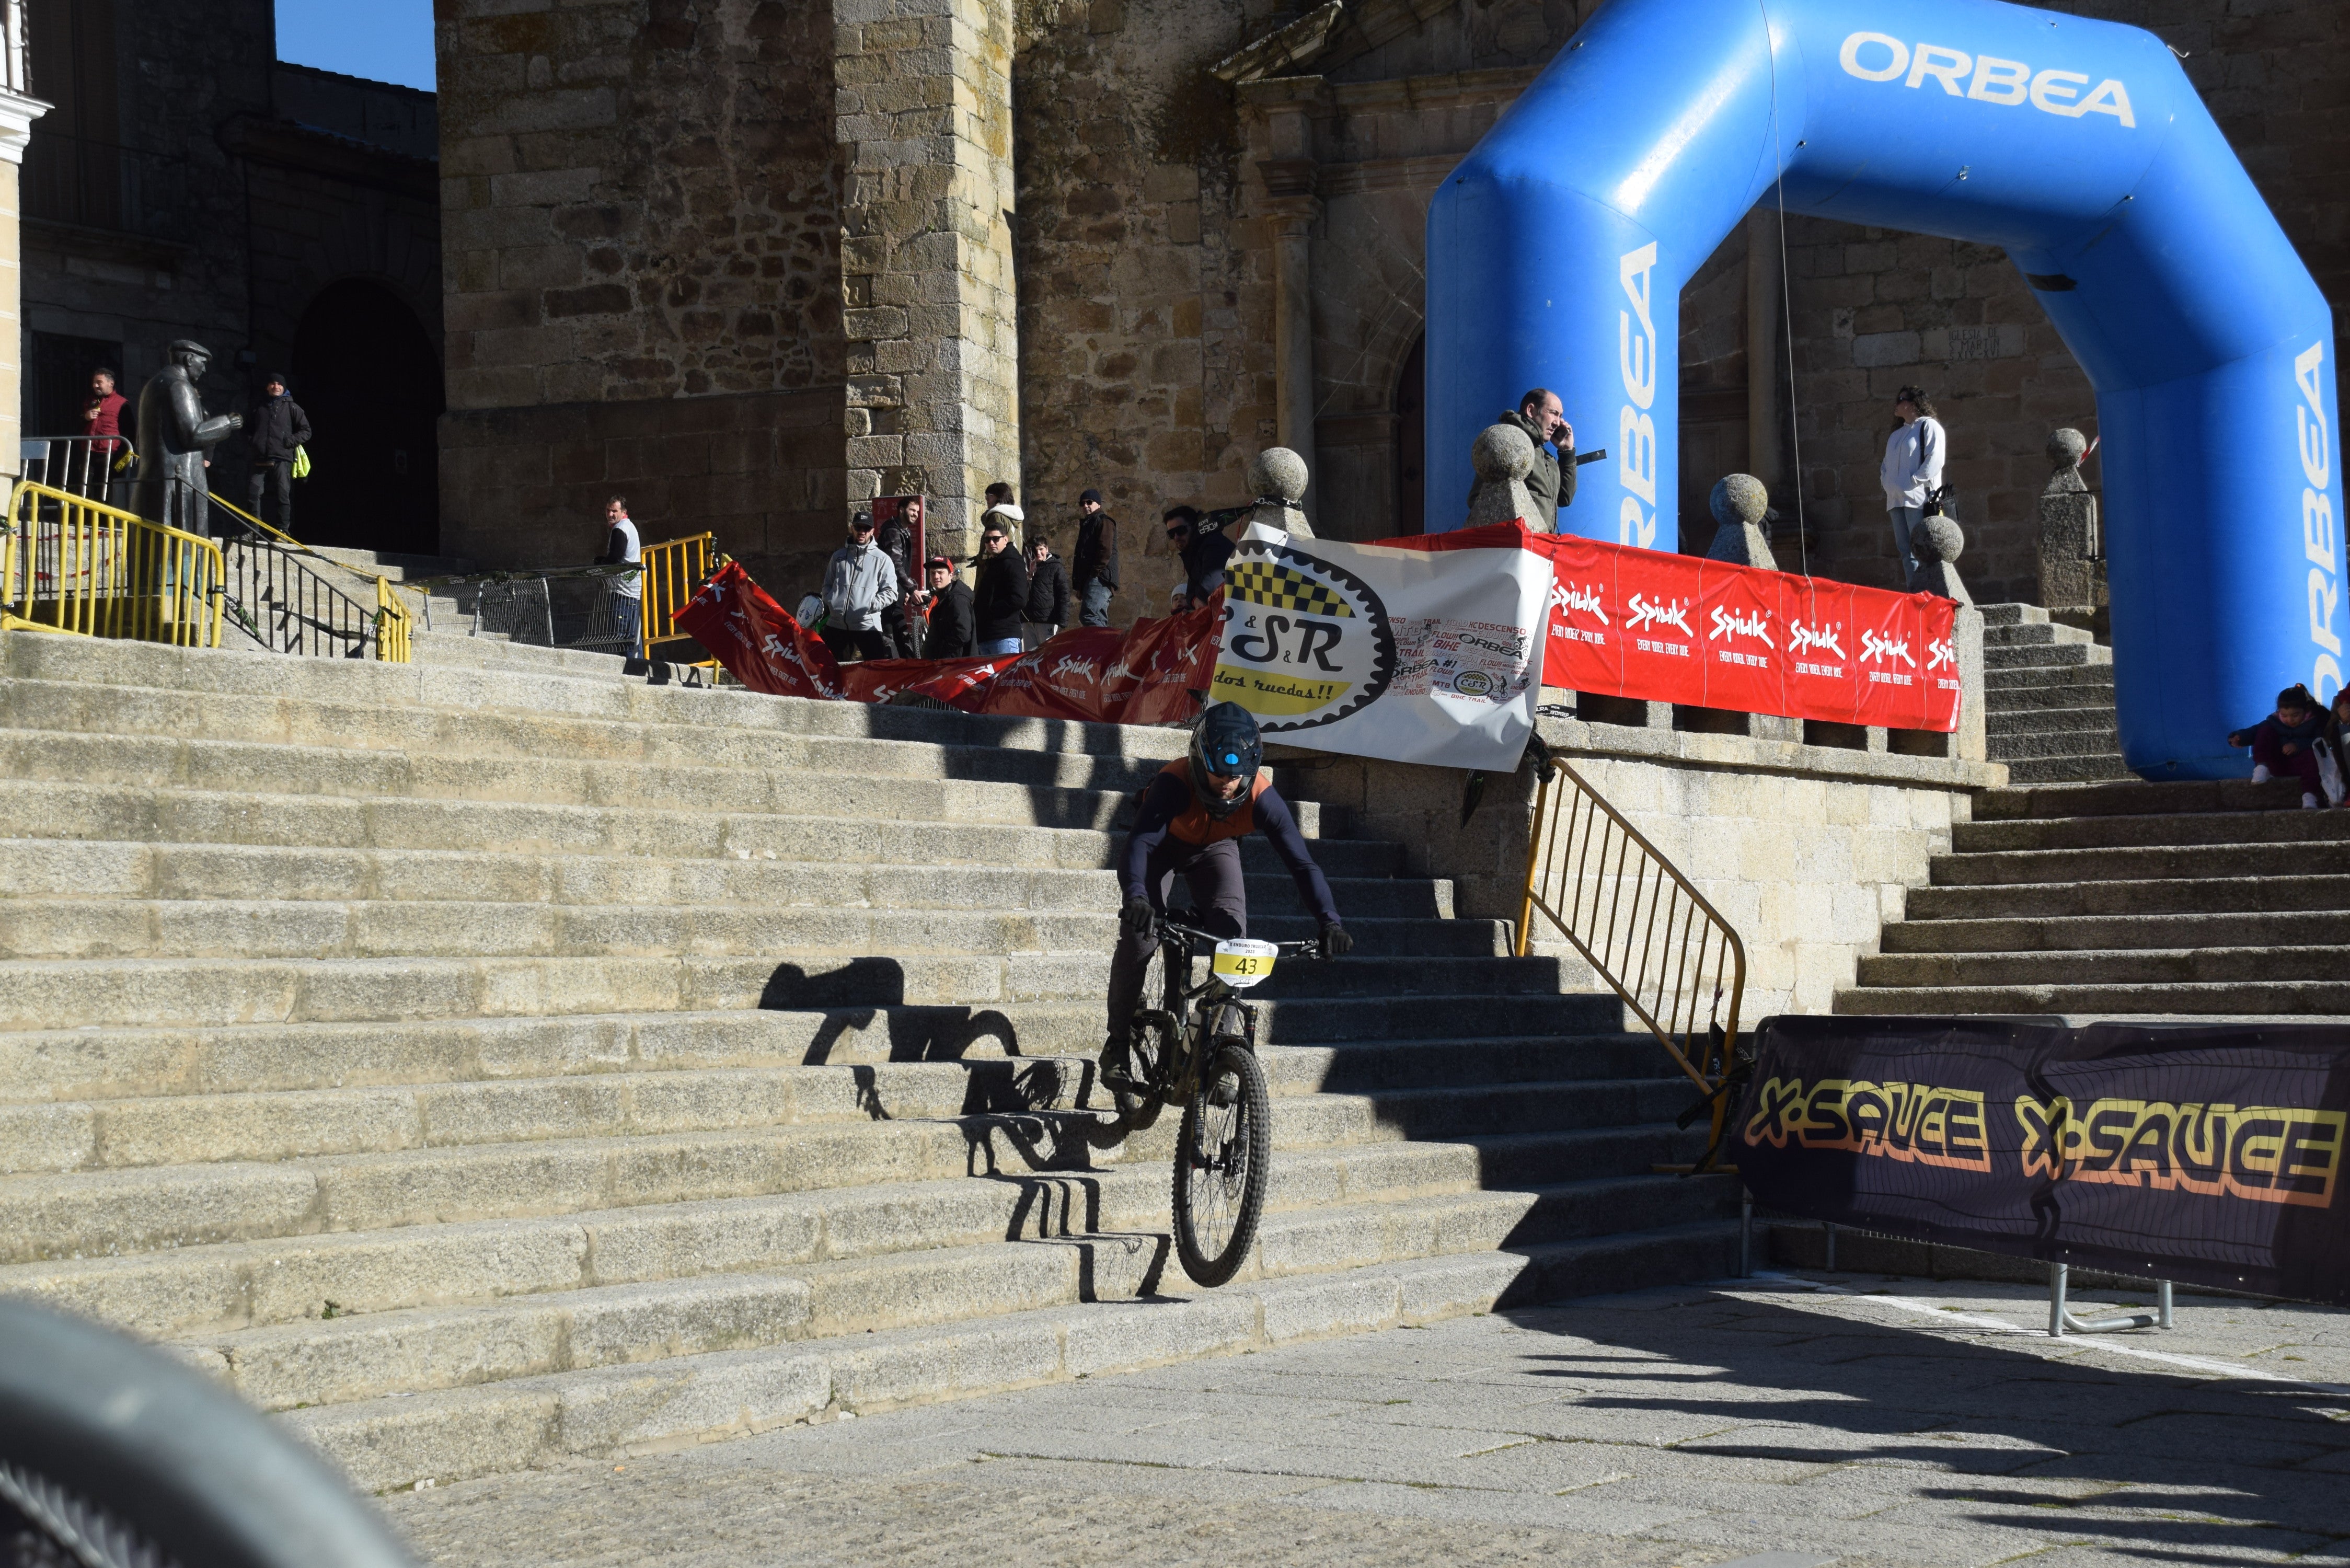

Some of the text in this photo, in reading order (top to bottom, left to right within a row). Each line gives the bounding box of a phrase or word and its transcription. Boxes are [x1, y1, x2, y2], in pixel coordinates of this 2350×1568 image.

[1839, 31, 2136, 129] ORBEA
[1949, 327, 1998, 341] IGLESIA DE
[1961, 338, 2000, 351] MARTIN
[1620, 241, 1657, 549] RBEA
[1391, 625, 1422, 636] MTB
[1477, 630, 1511, 640] ENDURO
[1478, 622, 1526, 635] DESCENSO
[1433, 639, 1461, 652] BIKE
[1458, 633, 1523, 660] ORBEA
[1442, 659, 1457, 668] #1
[1412, 668, 1428, 682] TRAIL
[1491, 672, 1502, 682] ROAD
[1214, 671, 1333, 699] dos ruedas!!
[1432, 680, 1450, 688] MTB
[1235, 958, 1258, 975] 43
